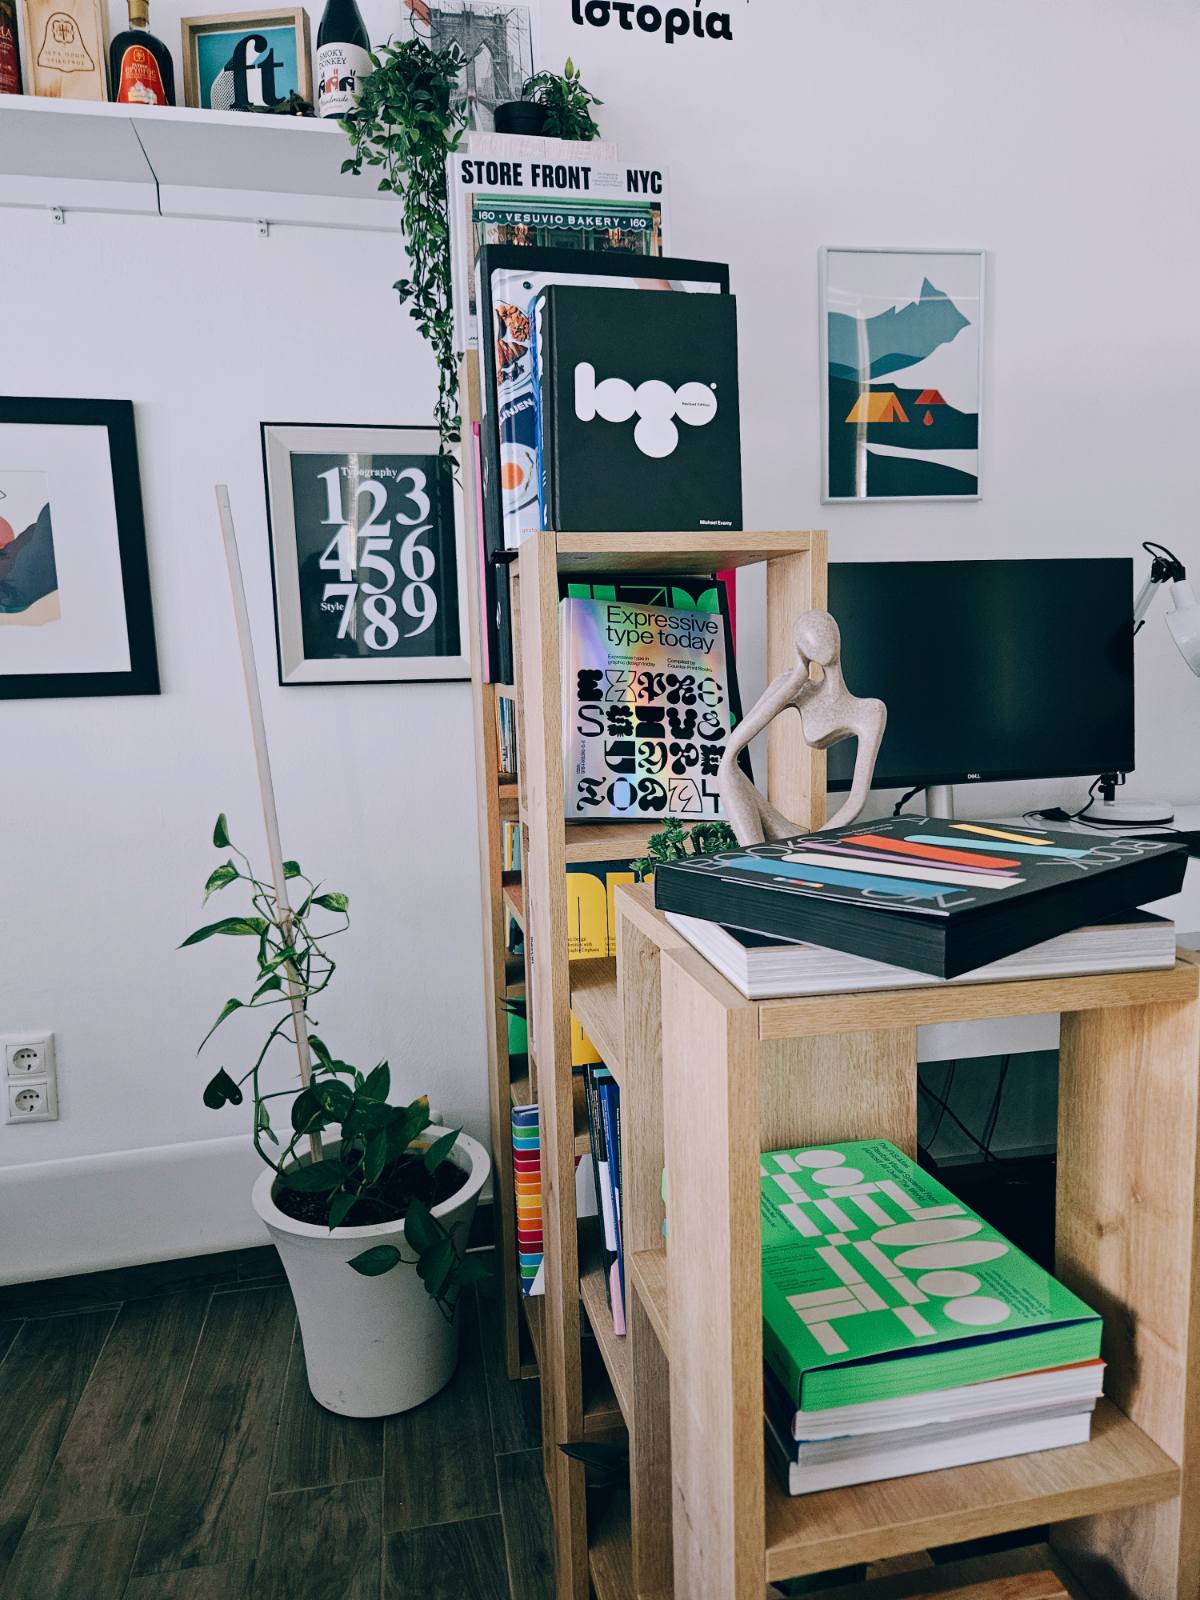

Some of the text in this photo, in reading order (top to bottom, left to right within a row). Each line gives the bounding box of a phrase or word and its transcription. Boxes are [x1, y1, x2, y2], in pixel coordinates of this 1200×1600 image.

[219, 34, 289, 108] ft
[461, 160, 523, 187] STORE
[531, 164, 592, 190] FRONT
[627, 169, 663, 194] NYC
[478, 211, 647, 228] 160 VESUVIO BAKERY 160
[575, 361, 718, 459] logo
[341, 466, 398, 478] Typography
[320, 602, 344, 613] Style
[608, 606, 719, 634] Expressive
[606, 626, 714, 654] type today
[677, 836, 843, 871] BOOKS
